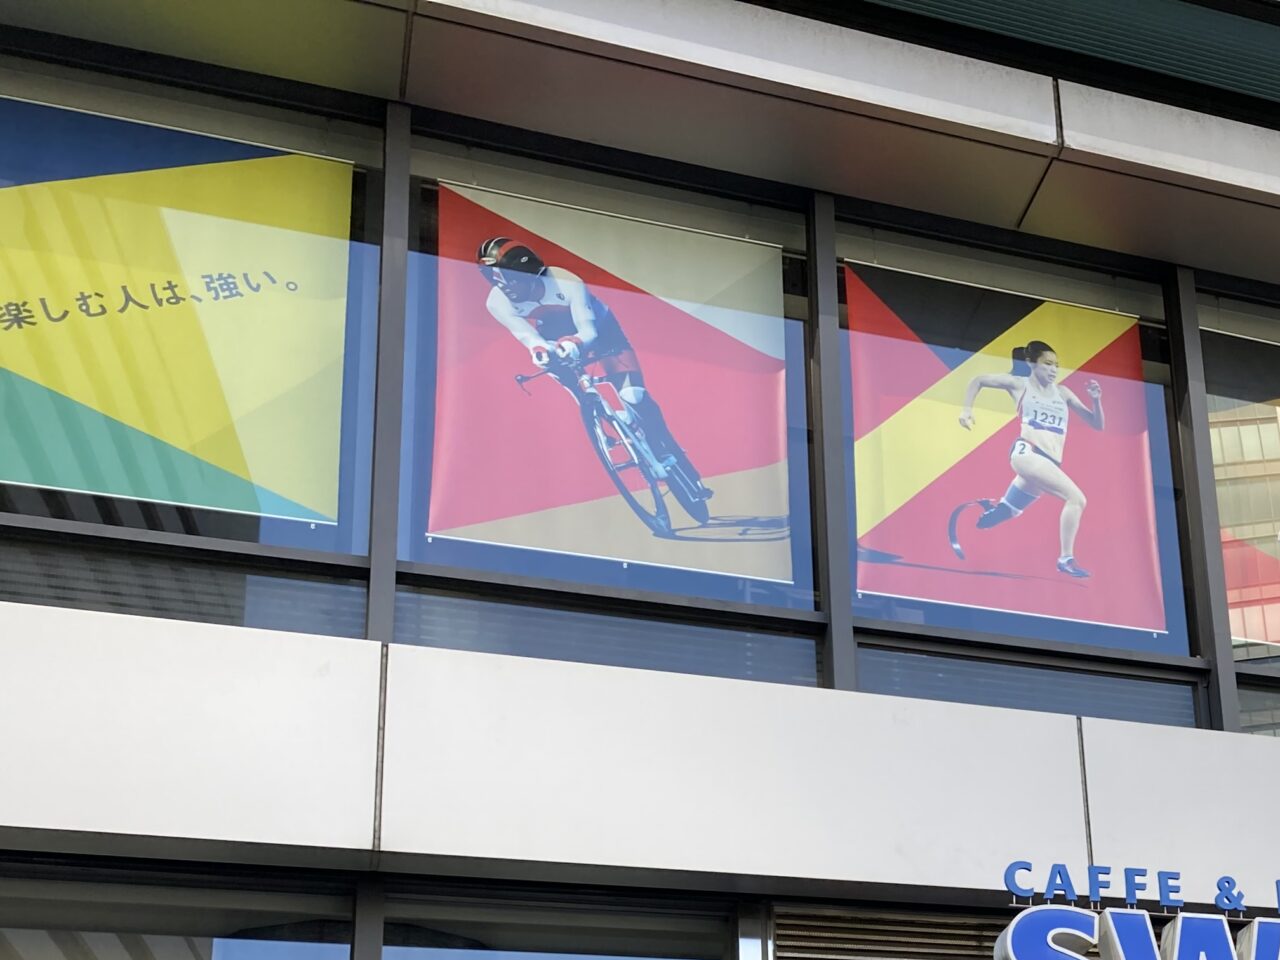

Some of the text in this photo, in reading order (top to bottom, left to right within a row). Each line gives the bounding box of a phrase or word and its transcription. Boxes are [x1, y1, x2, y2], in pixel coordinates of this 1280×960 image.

[0, 271, 298, 331] 楽しむ人は、強い。
[1033, 410, 1063, 426] 1231
[1019, 443, 1026, 454] 2
[1004, 861, 1184, 907] CAFFE
[1214, 876, 1246, 911] &
